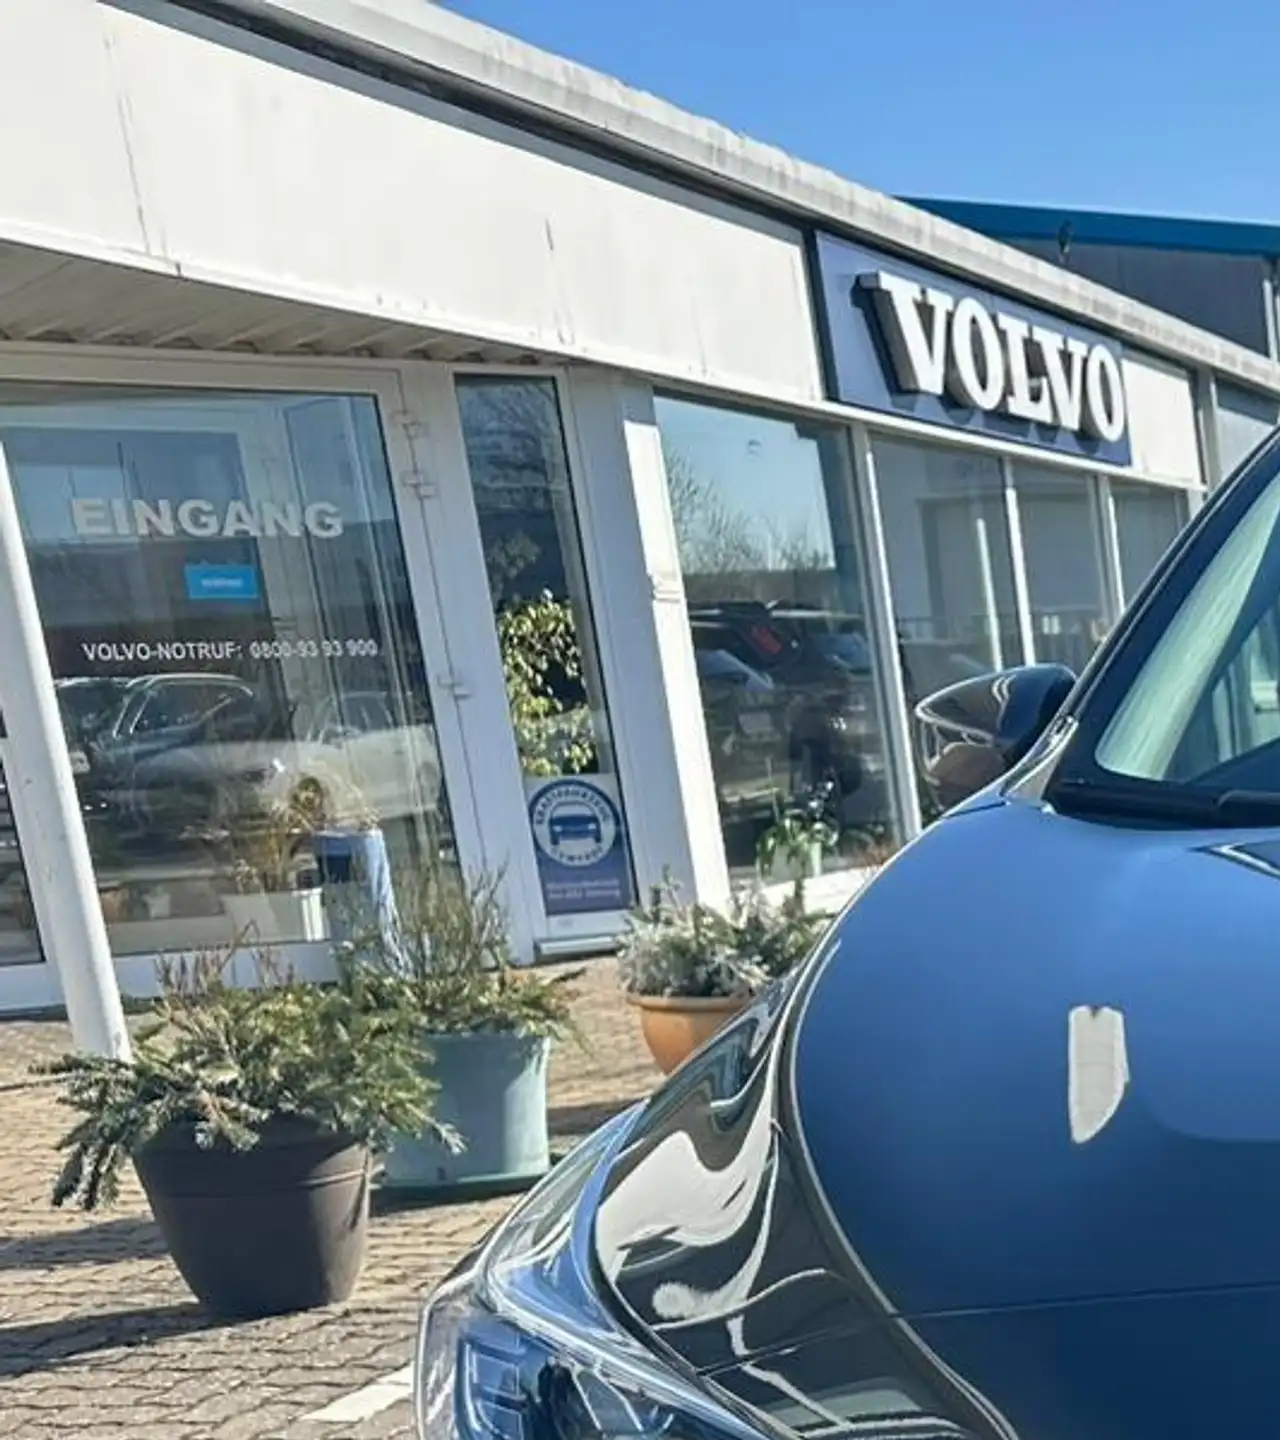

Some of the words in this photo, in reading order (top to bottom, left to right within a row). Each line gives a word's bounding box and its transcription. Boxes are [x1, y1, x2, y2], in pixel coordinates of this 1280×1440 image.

[864, 269, 1125, 442] VOLVO
[73, 499, 343, 538] EINGANG
[82, 641, 243, 661] VOLVO-NOTRUF:
